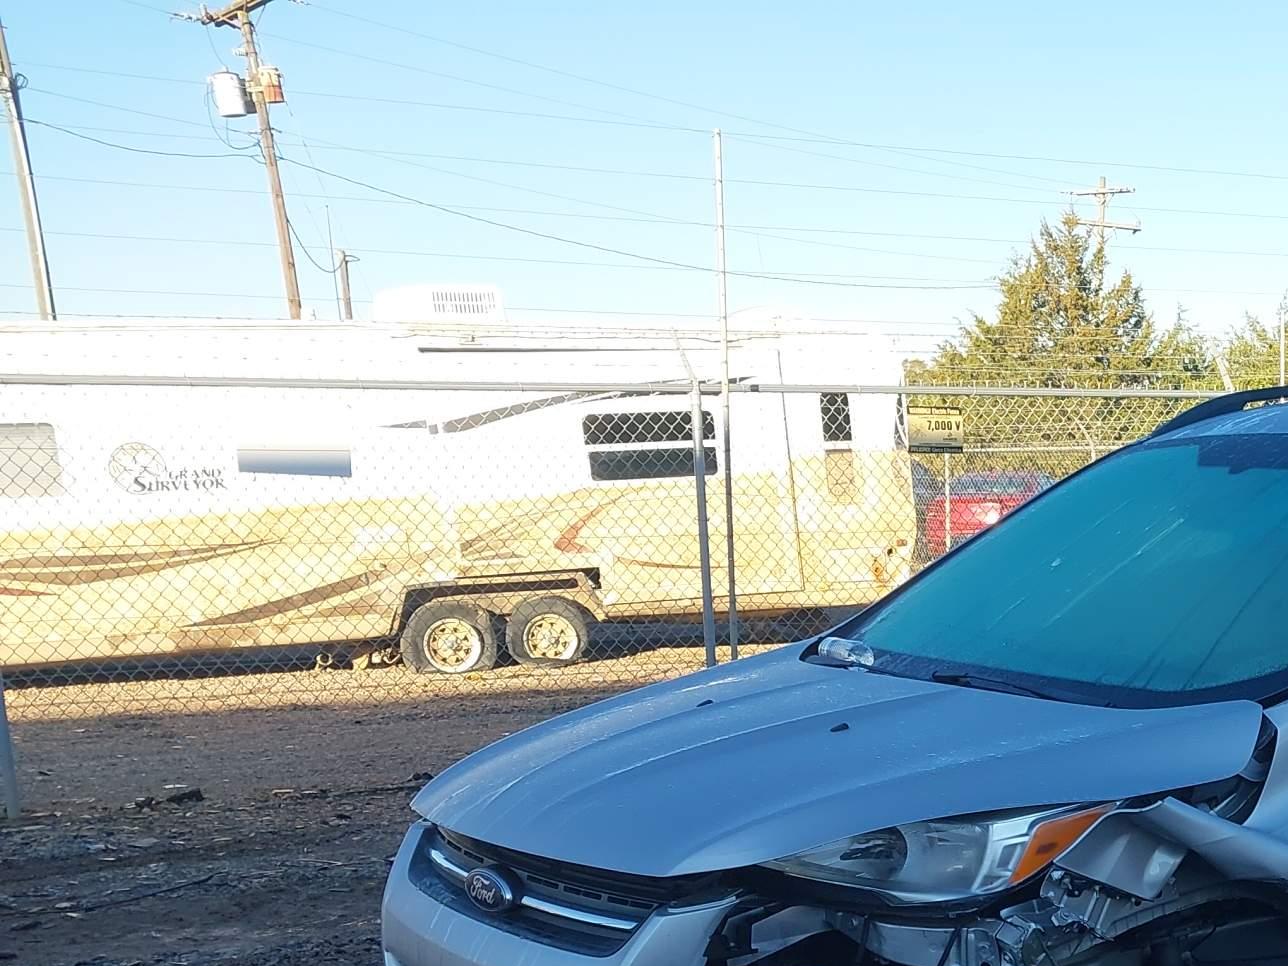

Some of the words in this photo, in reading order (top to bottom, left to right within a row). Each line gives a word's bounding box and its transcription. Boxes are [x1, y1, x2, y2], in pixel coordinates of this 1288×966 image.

[927, 420, 953, 432] 7,000
[955, 421, 961, 431] V
[168, 468, 222, 481] GRAND
[133, 475, 228, 495] SURVEYOR
[470, 875, 496, 904] Ford
